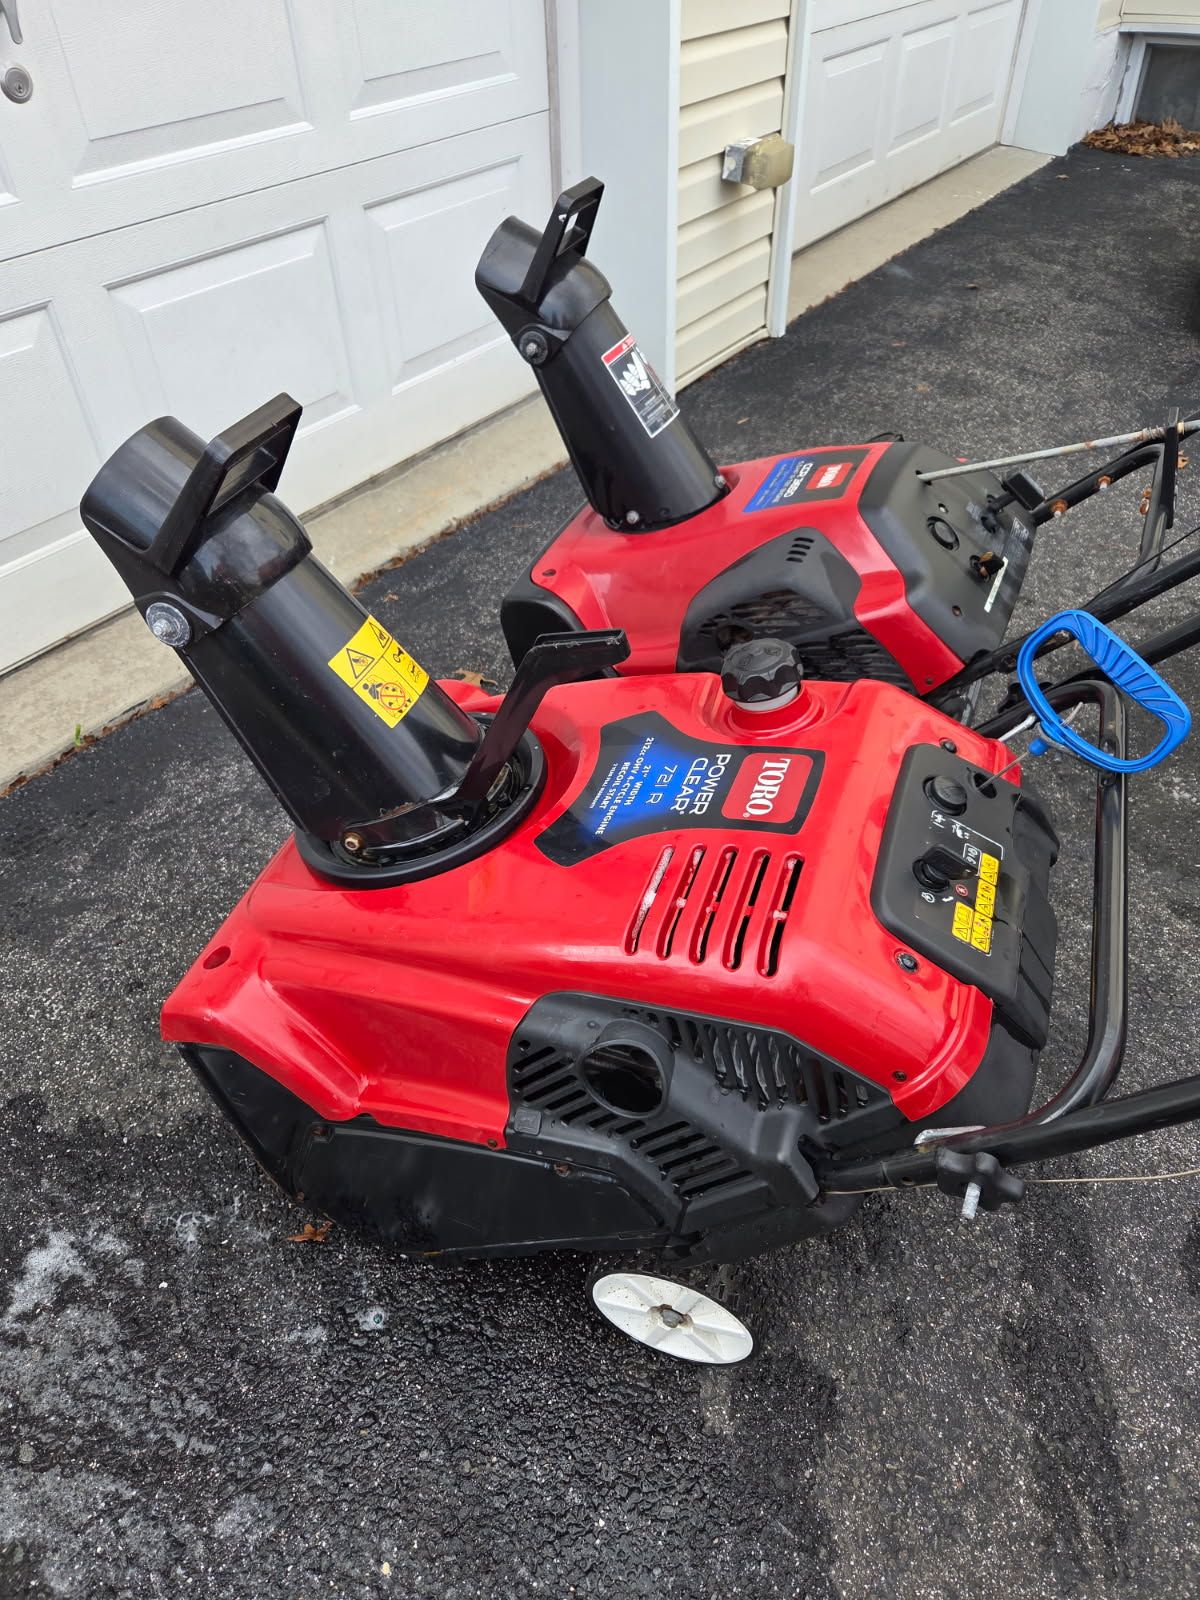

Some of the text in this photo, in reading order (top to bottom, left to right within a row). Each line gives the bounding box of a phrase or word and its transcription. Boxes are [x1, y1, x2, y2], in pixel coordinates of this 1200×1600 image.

[595, 737, 655, 835] 212cc OHV 4-CYCLE ENGINE
[599, 761, 631, 810] RECOIL START
[624, 781, 643, 806] WIDTH
[645, 764, 678, 804] 721 R
[670, 757, 709, 812] CLEAR
[689, 753, 732, 815] POWER
